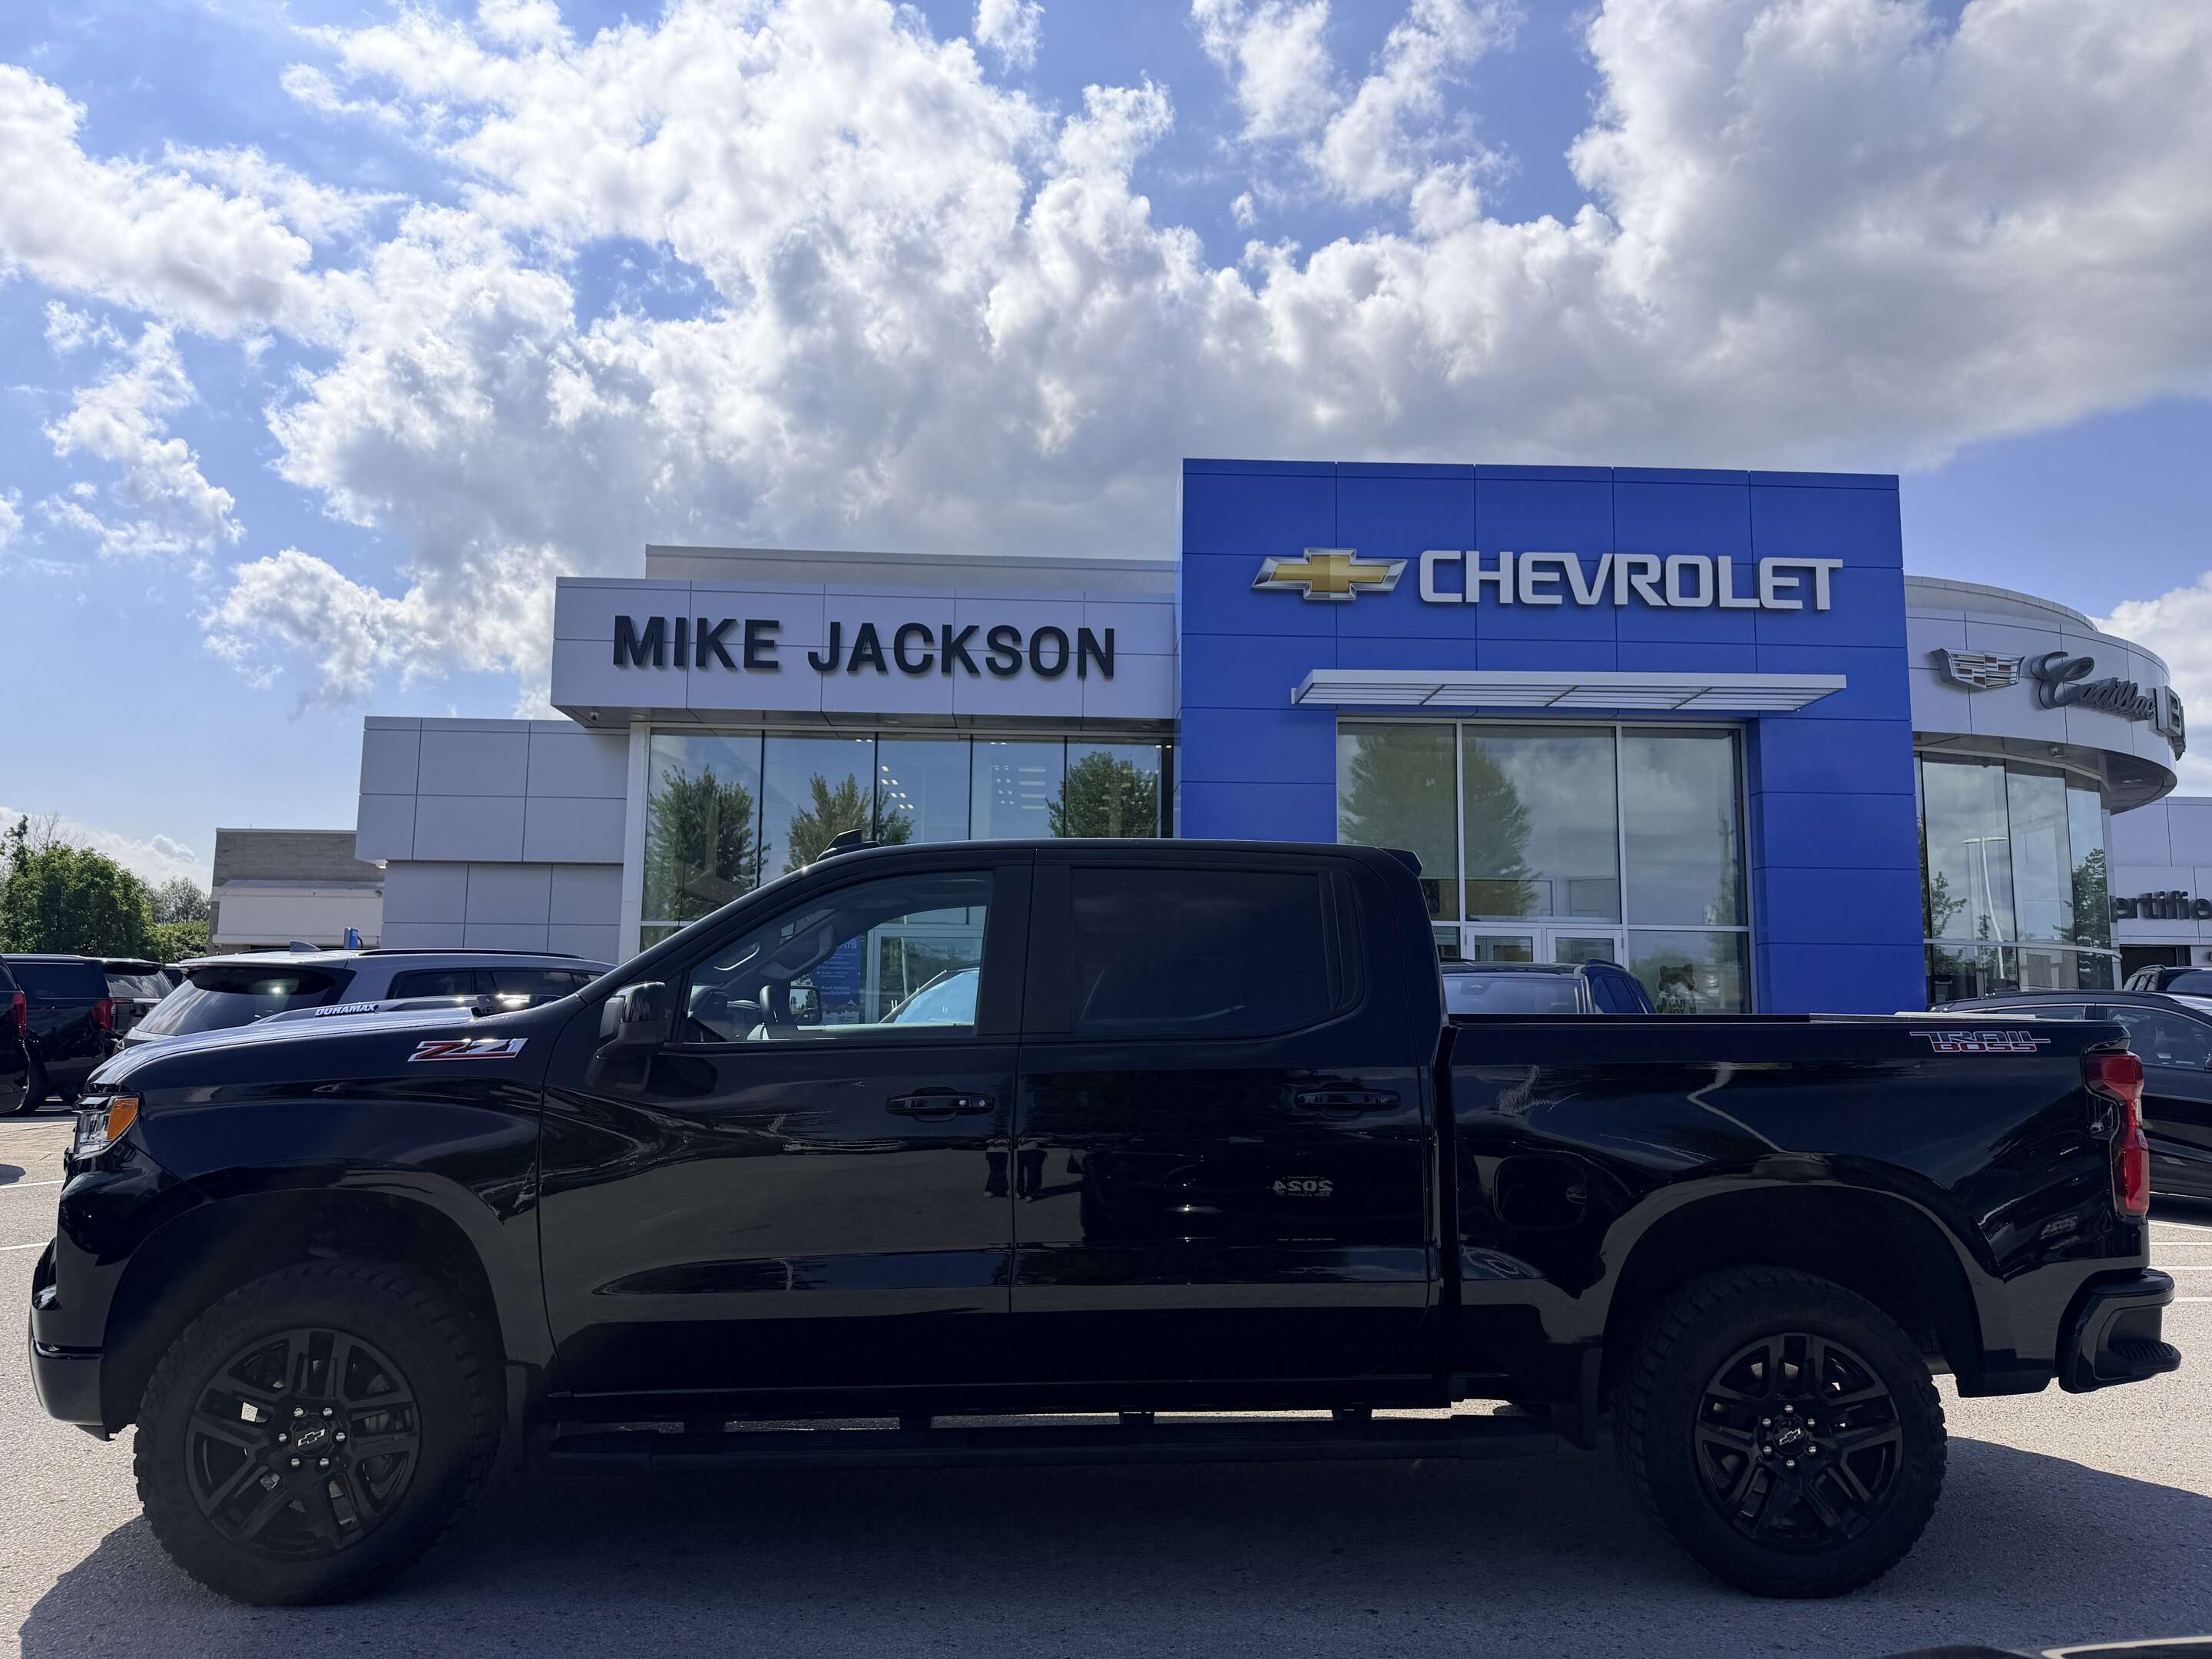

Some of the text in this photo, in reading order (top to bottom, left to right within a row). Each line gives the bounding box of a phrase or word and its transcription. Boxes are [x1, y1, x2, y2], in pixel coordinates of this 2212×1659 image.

[1419, 550, 1843, 611] CHEVROLET
[614, 615, 1115, 680] MIKE JACKSON
[2030, 651, 2155, 721] Cadillac
[2116, 890, 2212, 920] ertifie
[314, 1003, 378, 1017] DURAMAX
[407, 1038, 529, 1062] Z71
[1909, 1031, 2051, 1043] TRAIL
[1932, 1041, 2038, 1053] BOSS
